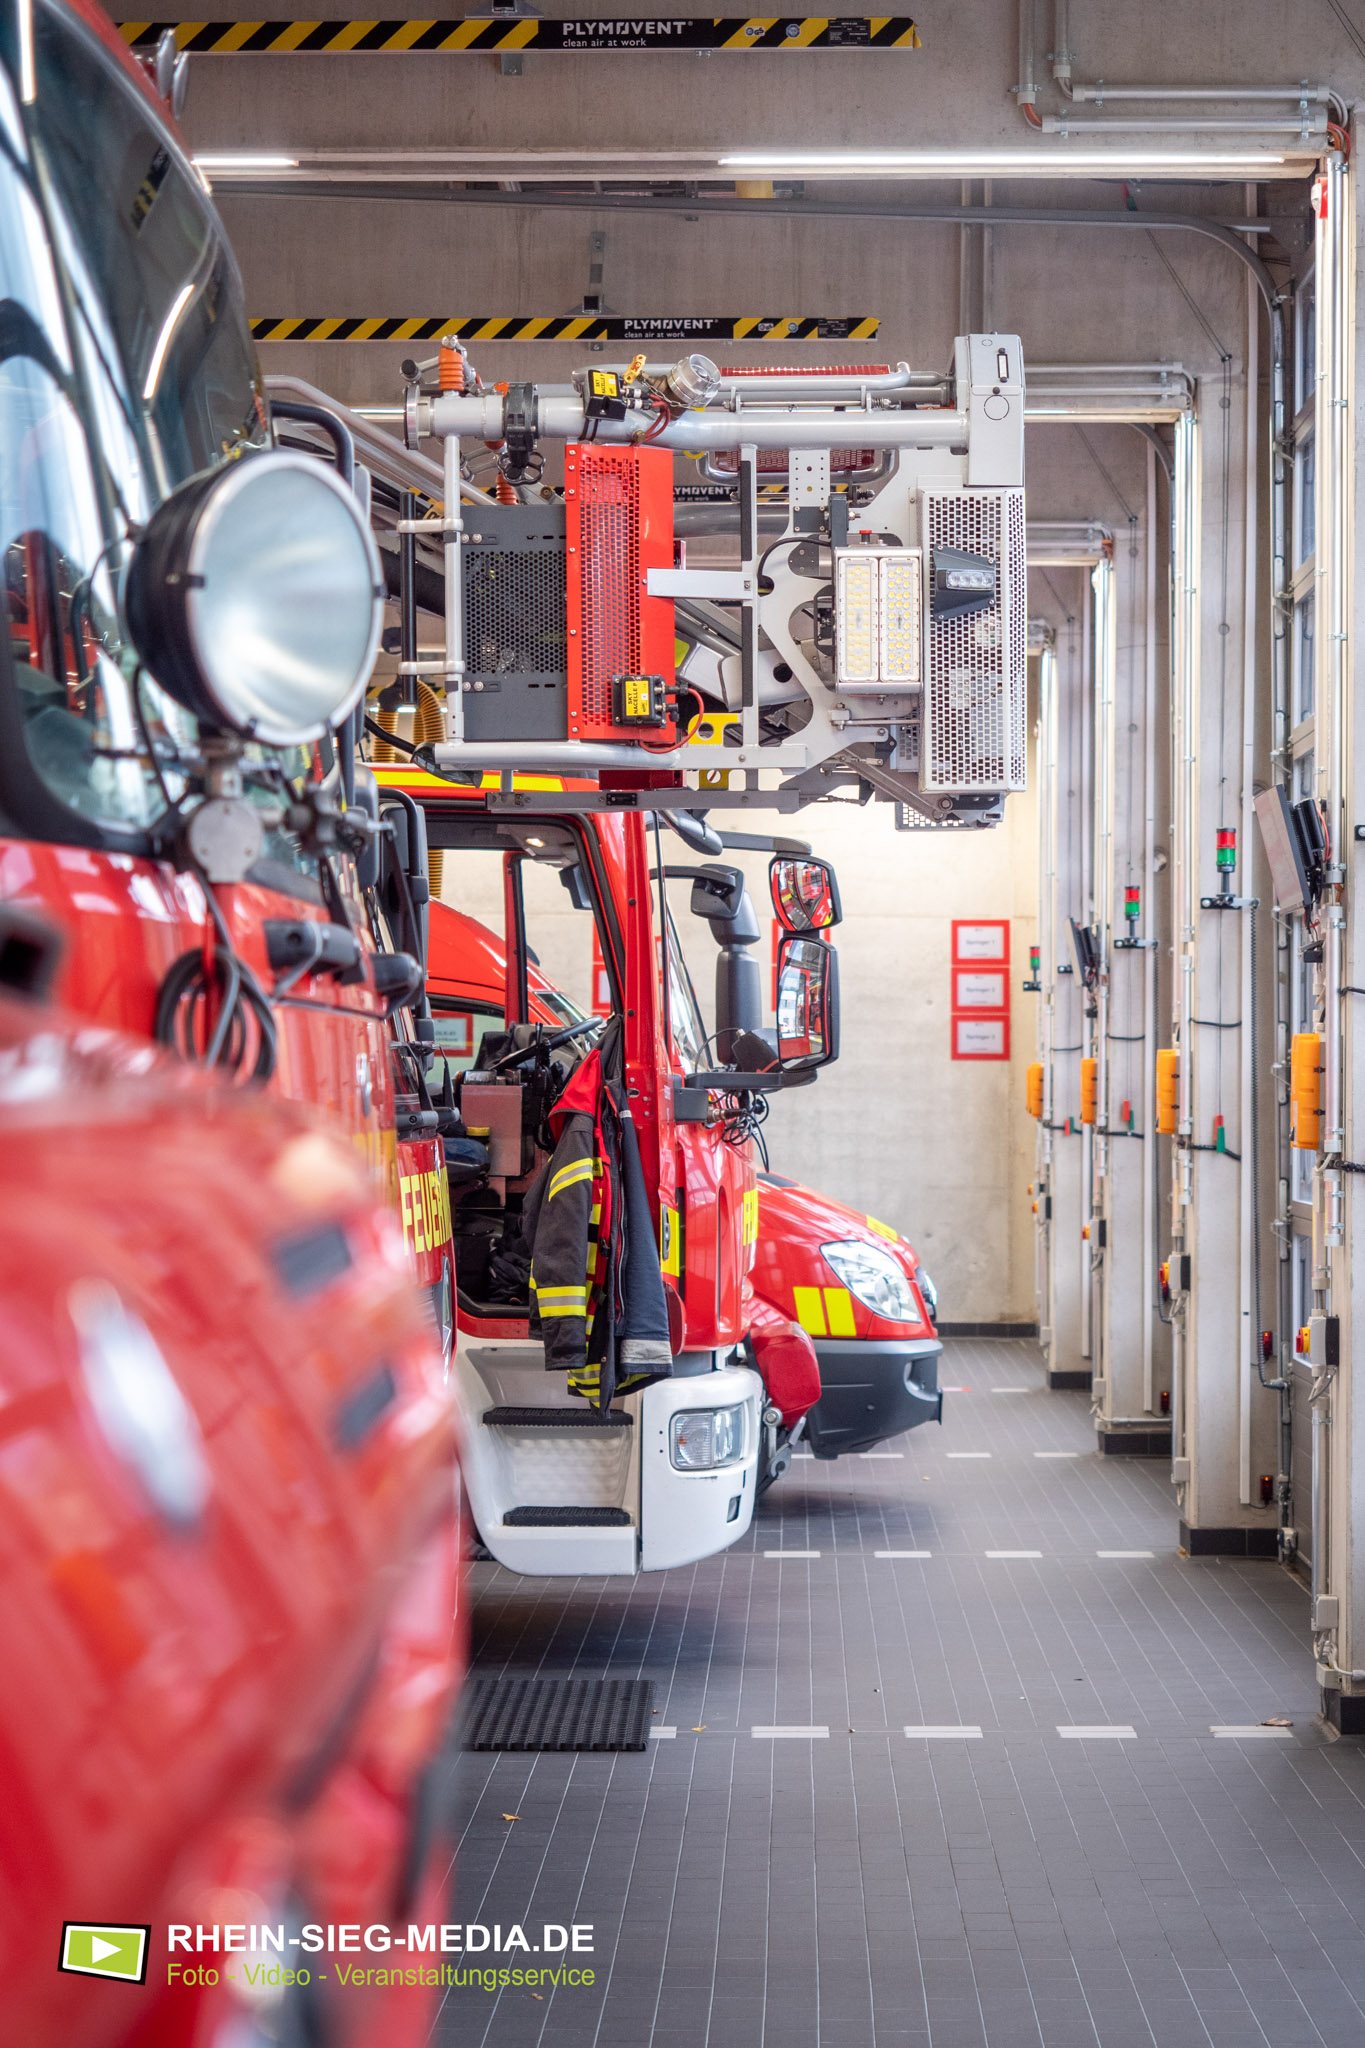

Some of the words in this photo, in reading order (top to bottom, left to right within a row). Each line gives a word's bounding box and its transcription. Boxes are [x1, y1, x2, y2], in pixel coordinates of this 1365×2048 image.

[562, 39, 588, 48] clean
[591, 39, 605, 47] air
[607, 39, 618, 47] at
[621, 38, 647, 47] work
